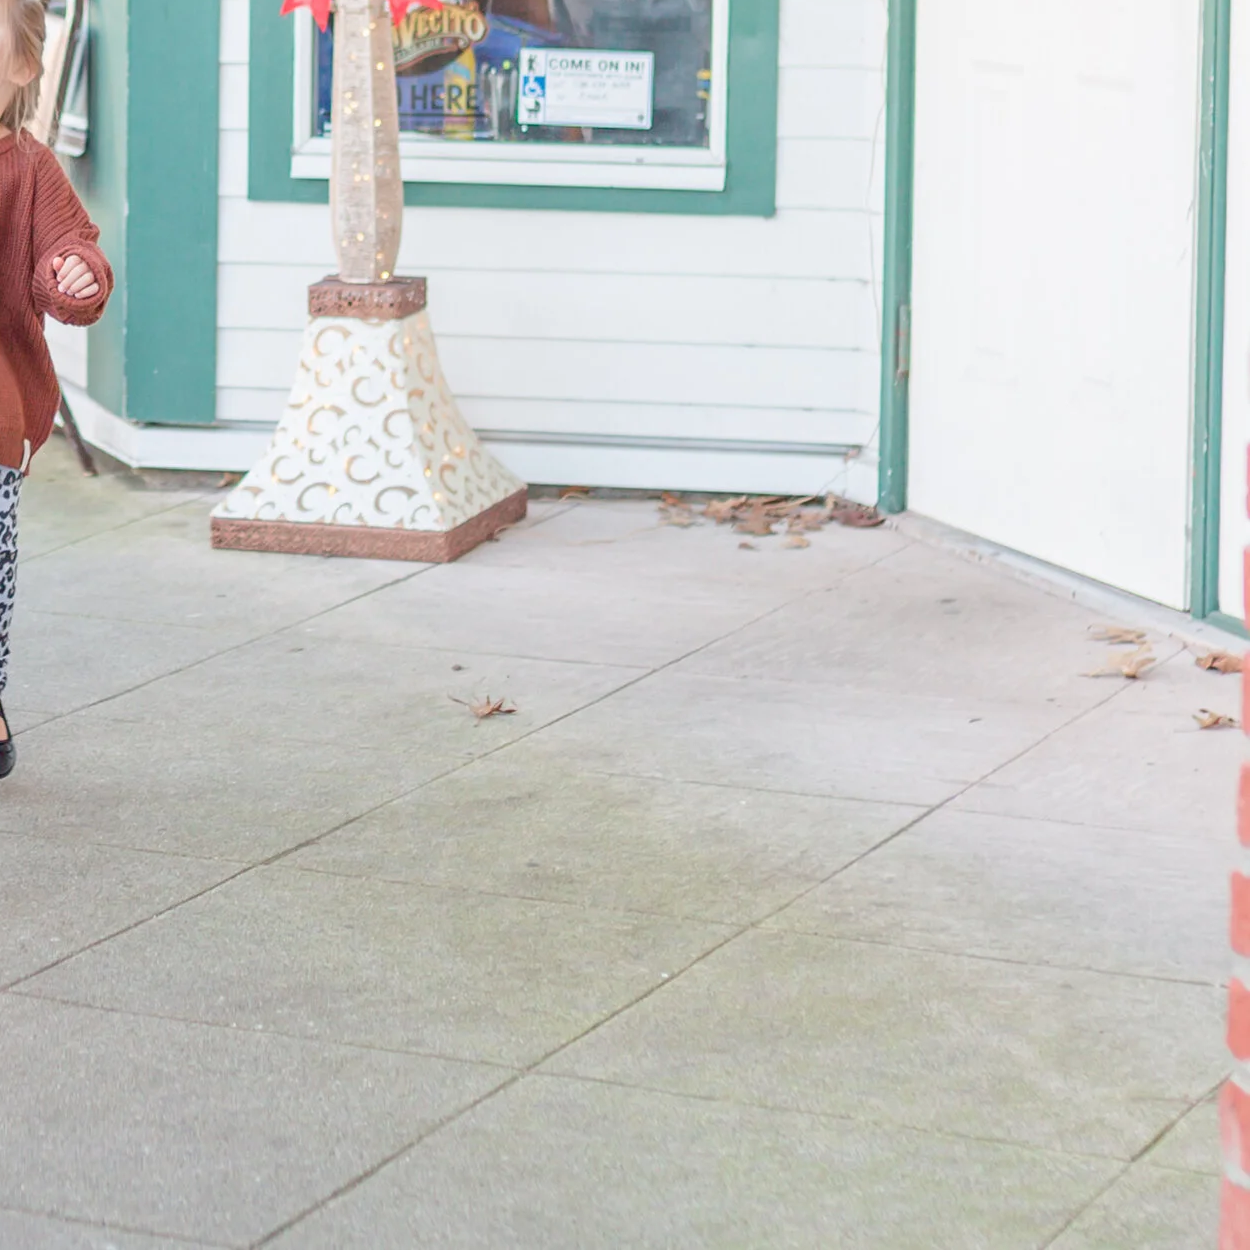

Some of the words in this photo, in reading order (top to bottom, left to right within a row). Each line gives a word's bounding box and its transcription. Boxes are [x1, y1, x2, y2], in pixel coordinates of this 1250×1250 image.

[549, 58, 592, 72] COME
[598, 60, 619, 72] ON
[625, 61, 645, 75] IN!
[411, 84, 480, 111] HERE
